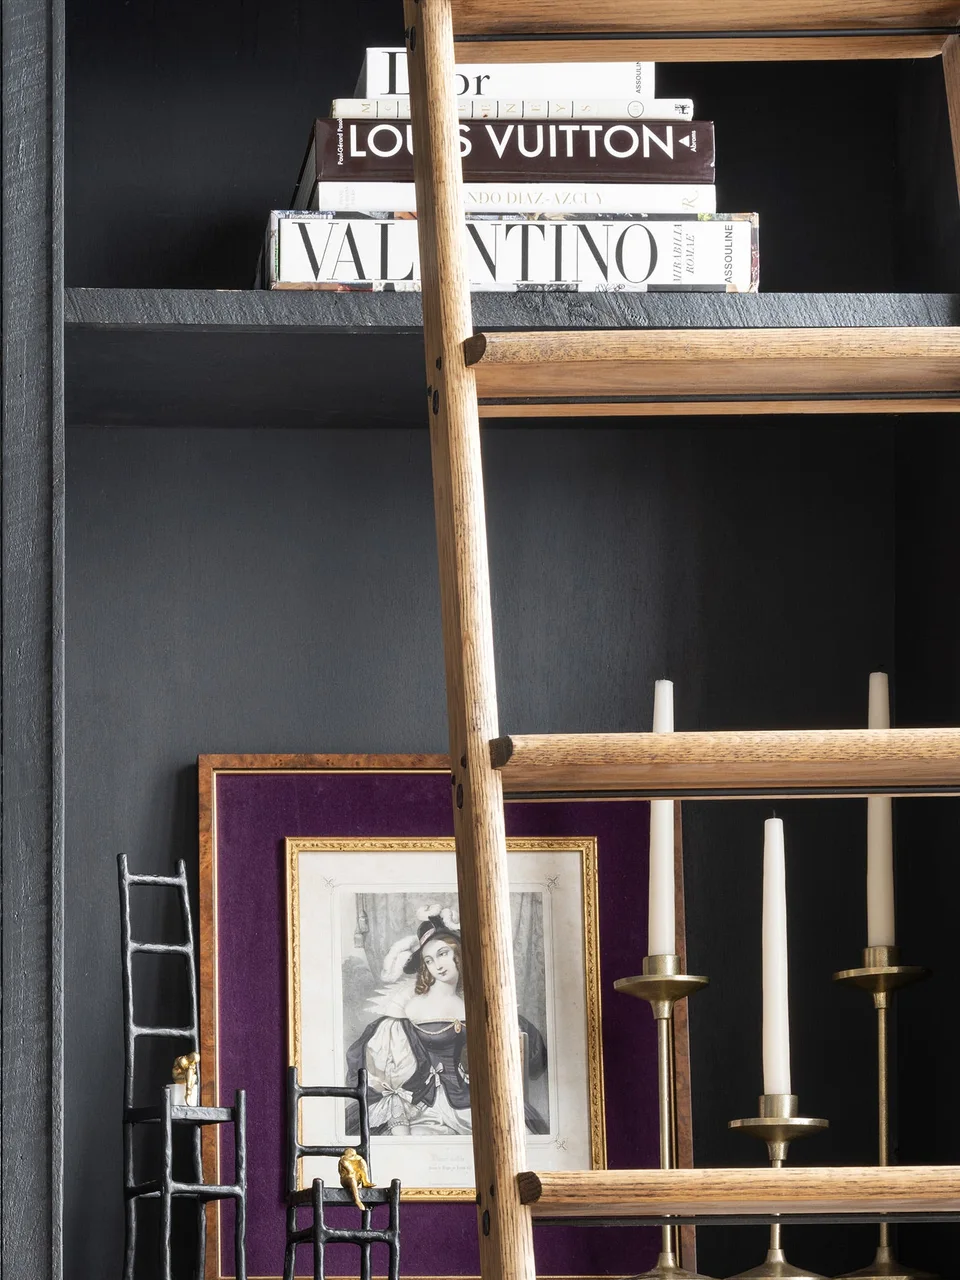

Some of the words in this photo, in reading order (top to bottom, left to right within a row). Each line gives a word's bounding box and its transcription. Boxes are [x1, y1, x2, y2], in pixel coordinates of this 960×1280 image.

[381, 51, 491, 96] Dor
[350, 124, 473, 158] LOS
[485, 124, 674, 160] VUITTON
[292, 222, 658, 284] VALNTINO
[673, 223, 683, 284] MIRABILIA
[685, 234, 695, 274] ROMAE
[724, 224, 733, 283] ASSOULINE
